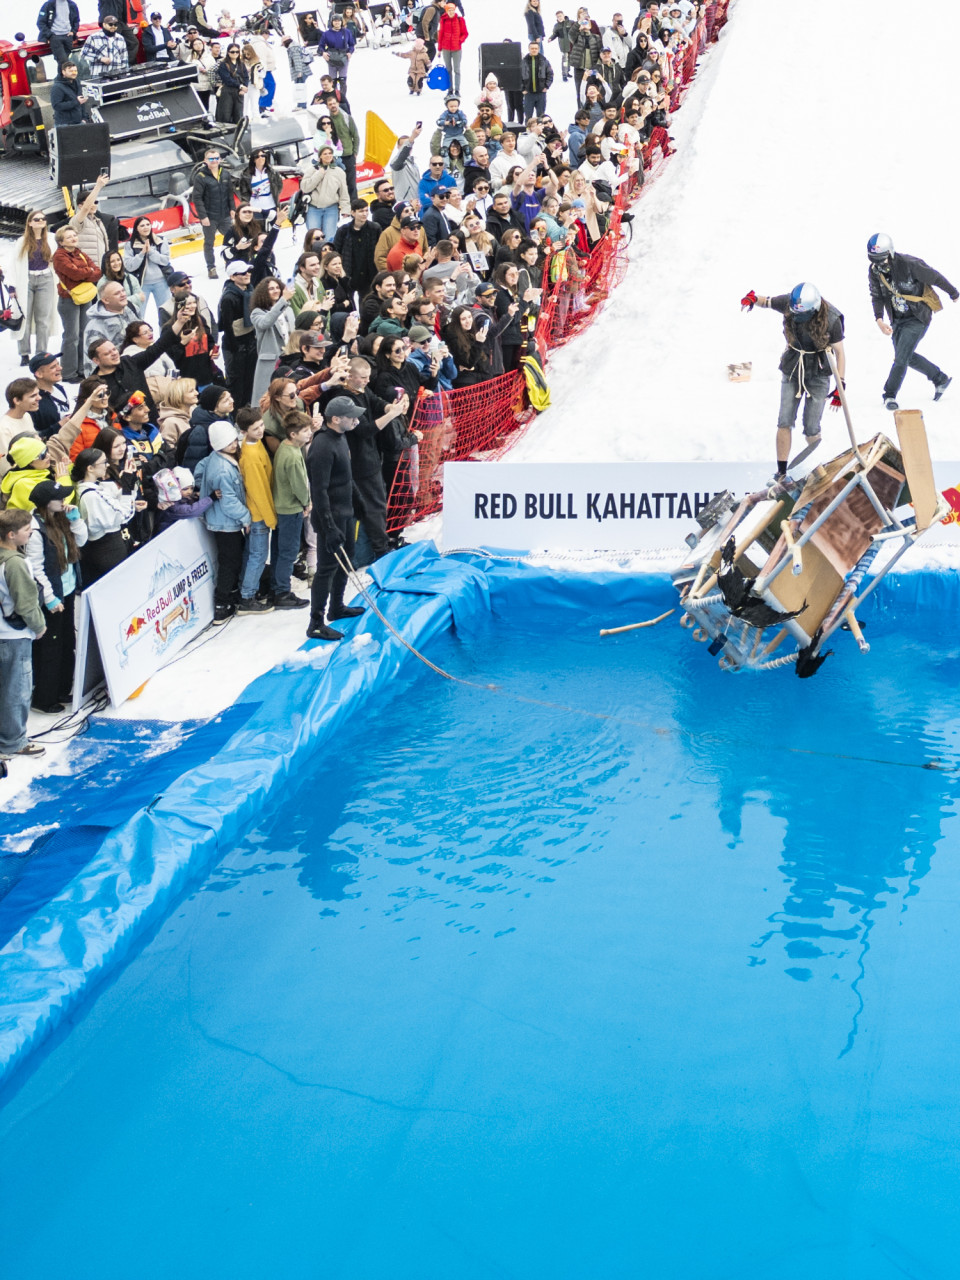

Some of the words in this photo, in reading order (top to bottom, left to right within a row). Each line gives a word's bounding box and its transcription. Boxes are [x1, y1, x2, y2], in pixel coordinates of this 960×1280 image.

[136, 113, 154, 122] Red
[154, 108, 171, 118] Bull
[474, 492, 517, 519] RED
[524, 492, 578, 519] BULL
[146, 600, 161, 621] Red
[159, 590, 172, 611] Bull
[172, 578, 186, 600] JUMP
[186, 575, 192, 588] &
[191, 561, 208, 583] FREEZE
